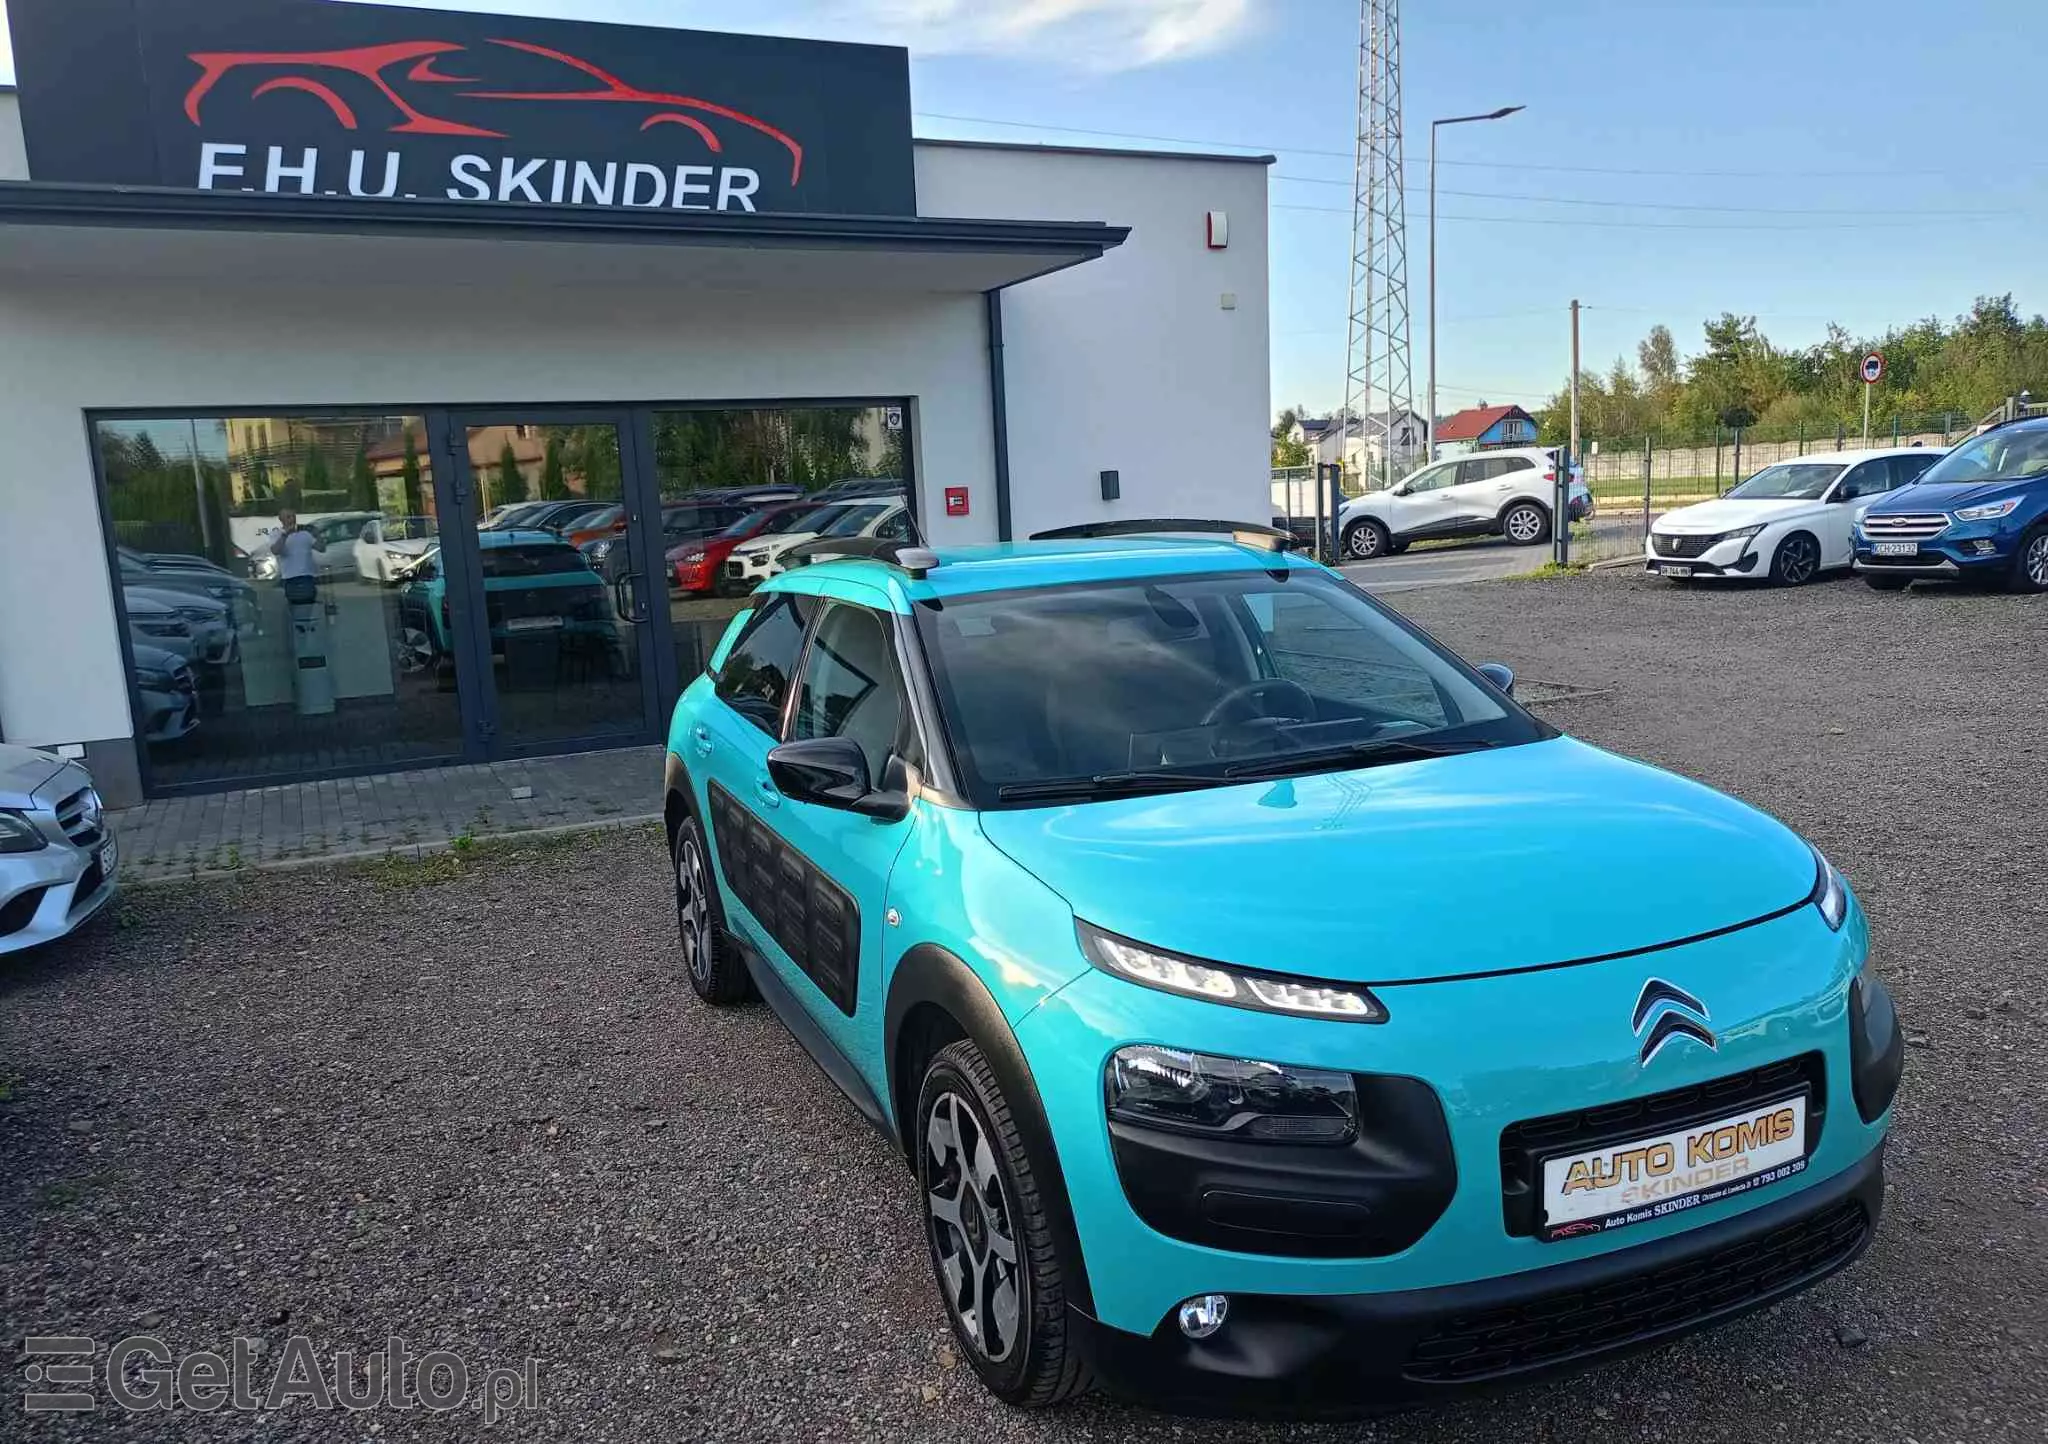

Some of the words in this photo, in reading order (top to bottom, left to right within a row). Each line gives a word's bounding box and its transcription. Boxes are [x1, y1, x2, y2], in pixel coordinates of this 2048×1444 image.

[446, 154, 760, 213] SKINDER
[1561, 1142, 1675, 1195] AUTO
[1687, 1107, 1795, 1168] KOMIS
[1622, 1157, 1749, 1203] SKINDER
[1605, 1216, 1625, 1229] Auto
[1626, 1209, 1653, 1224] Komis
[1653, 1194, 1701, 1217] SKINDER
[1760, 1172, 1775, 1185] 793
